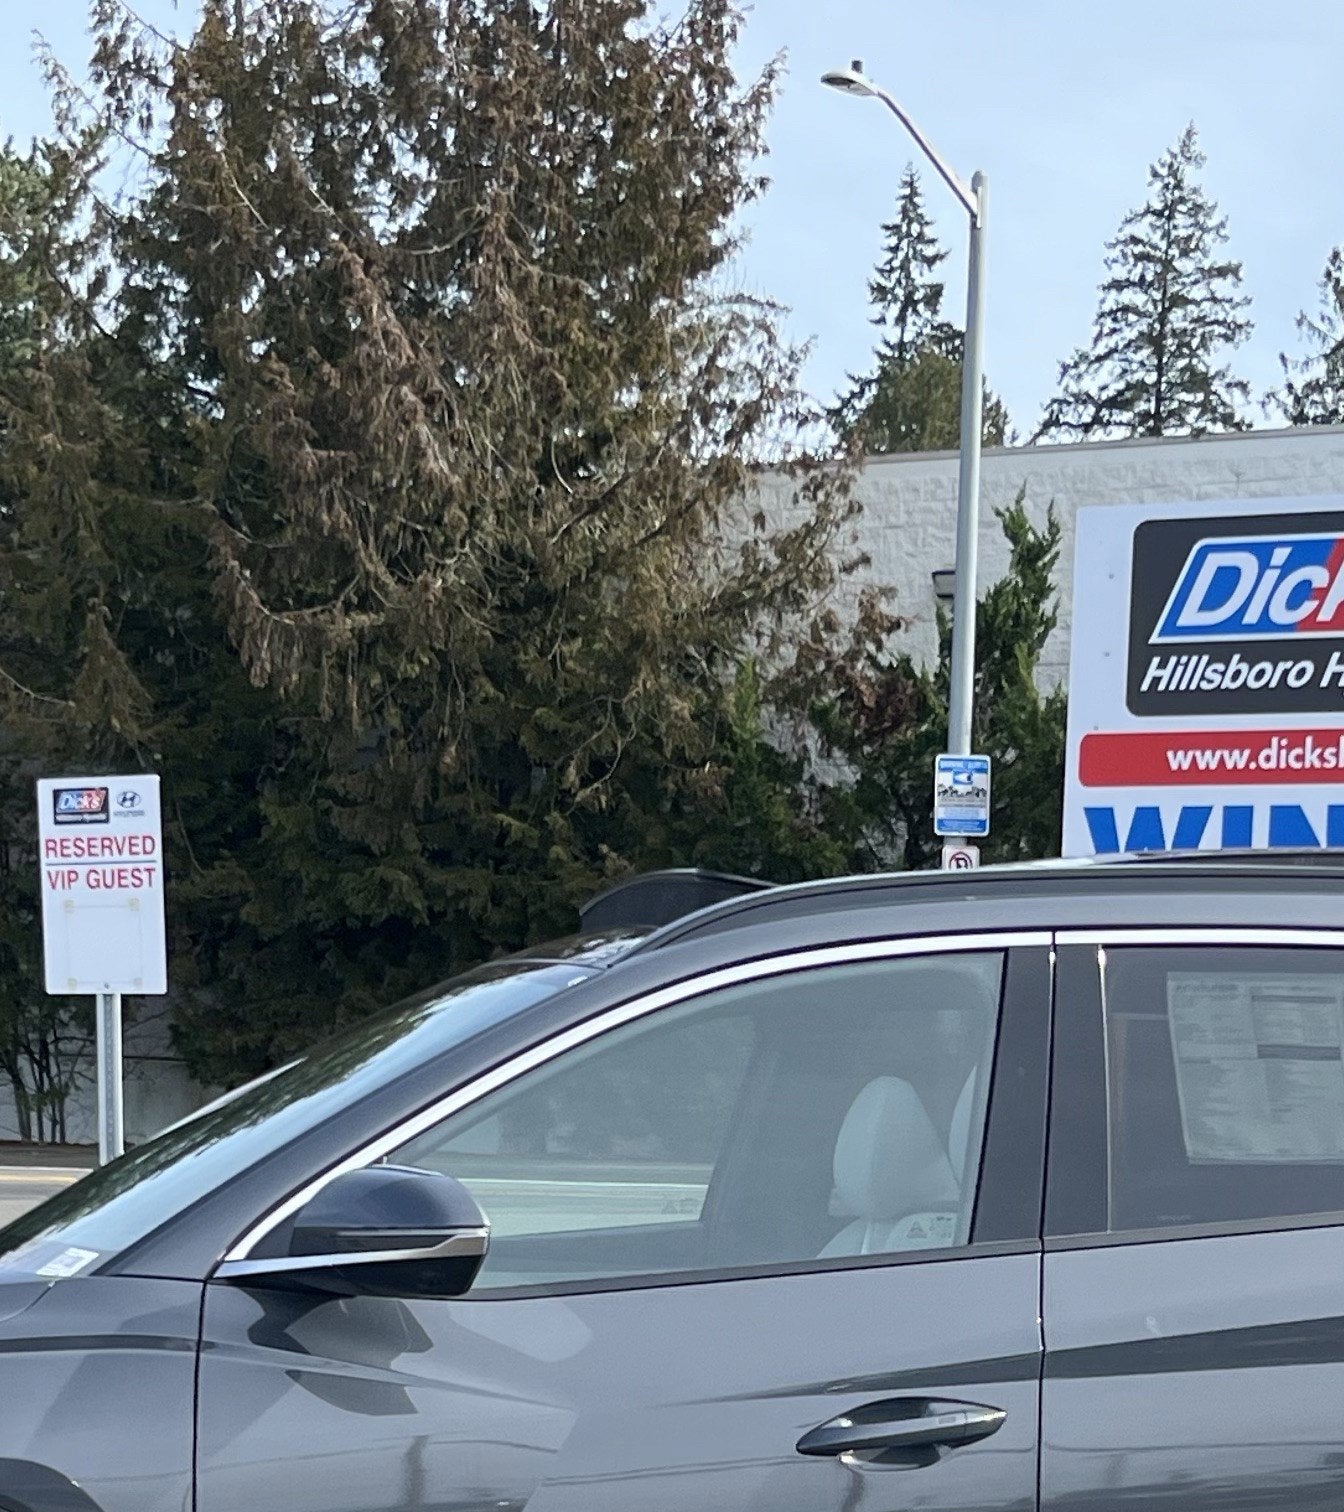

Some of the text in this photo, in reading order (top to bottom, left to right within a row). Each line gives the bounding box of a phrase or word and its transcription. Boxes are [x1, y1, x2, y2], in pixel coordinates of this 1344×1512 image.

[1139, 652, 1315, 692] Hillsboro
[45, 835, 156, 859] RESERVED
[47, 867, 156, 891] VIP GUEST
